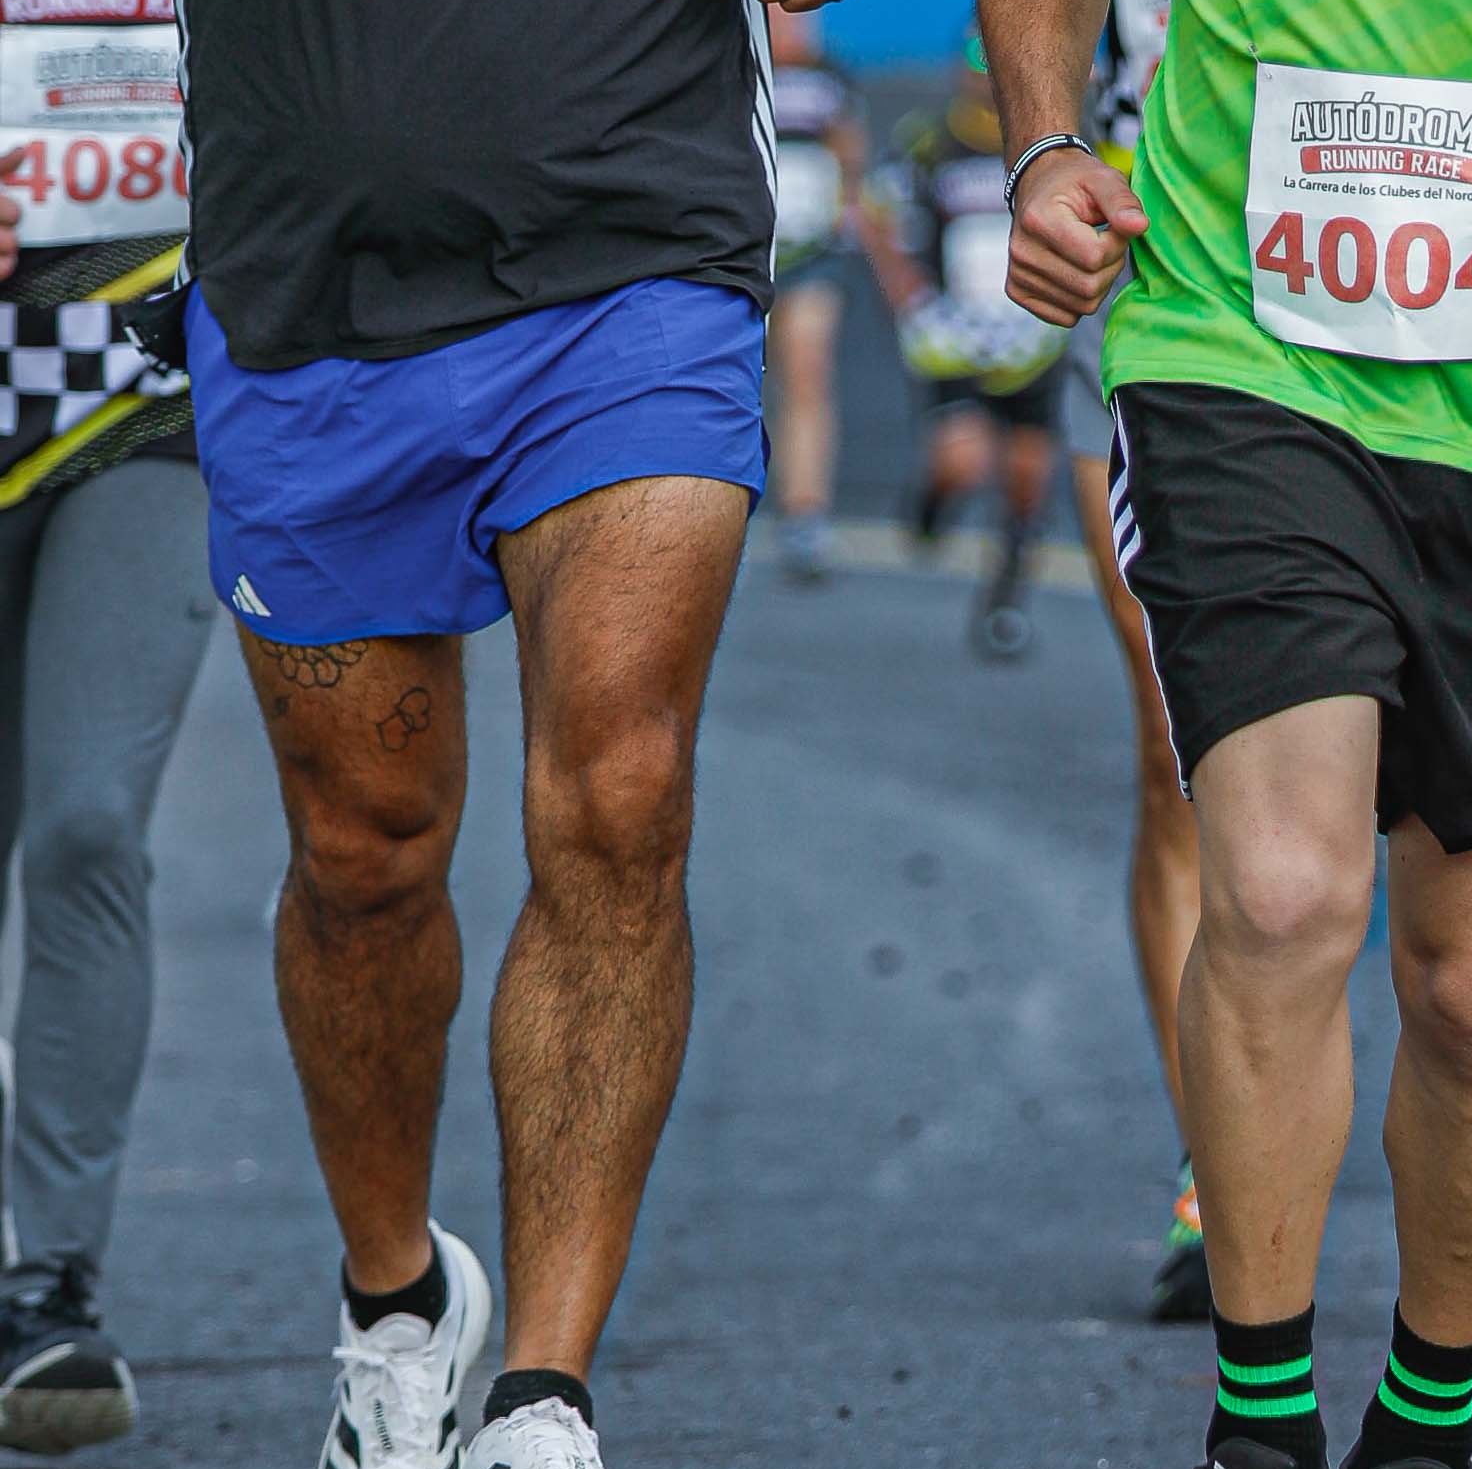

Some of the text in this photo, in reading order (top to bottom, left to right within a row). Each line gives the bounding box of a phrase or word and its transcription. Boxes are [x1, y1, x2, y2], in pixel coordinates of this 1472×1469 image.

[1320, 149, 1463, 181] RUNNING RACE
[1284, 176, 1296, 188] La
[1298, 178, 1339, 193] Carrera
[1341, 182, 1356, 195] de
[1359, 183, 1376, 196] los
[1379, 184, 1420, 198] Clubes
[1423, 187, 1442, 200] del
